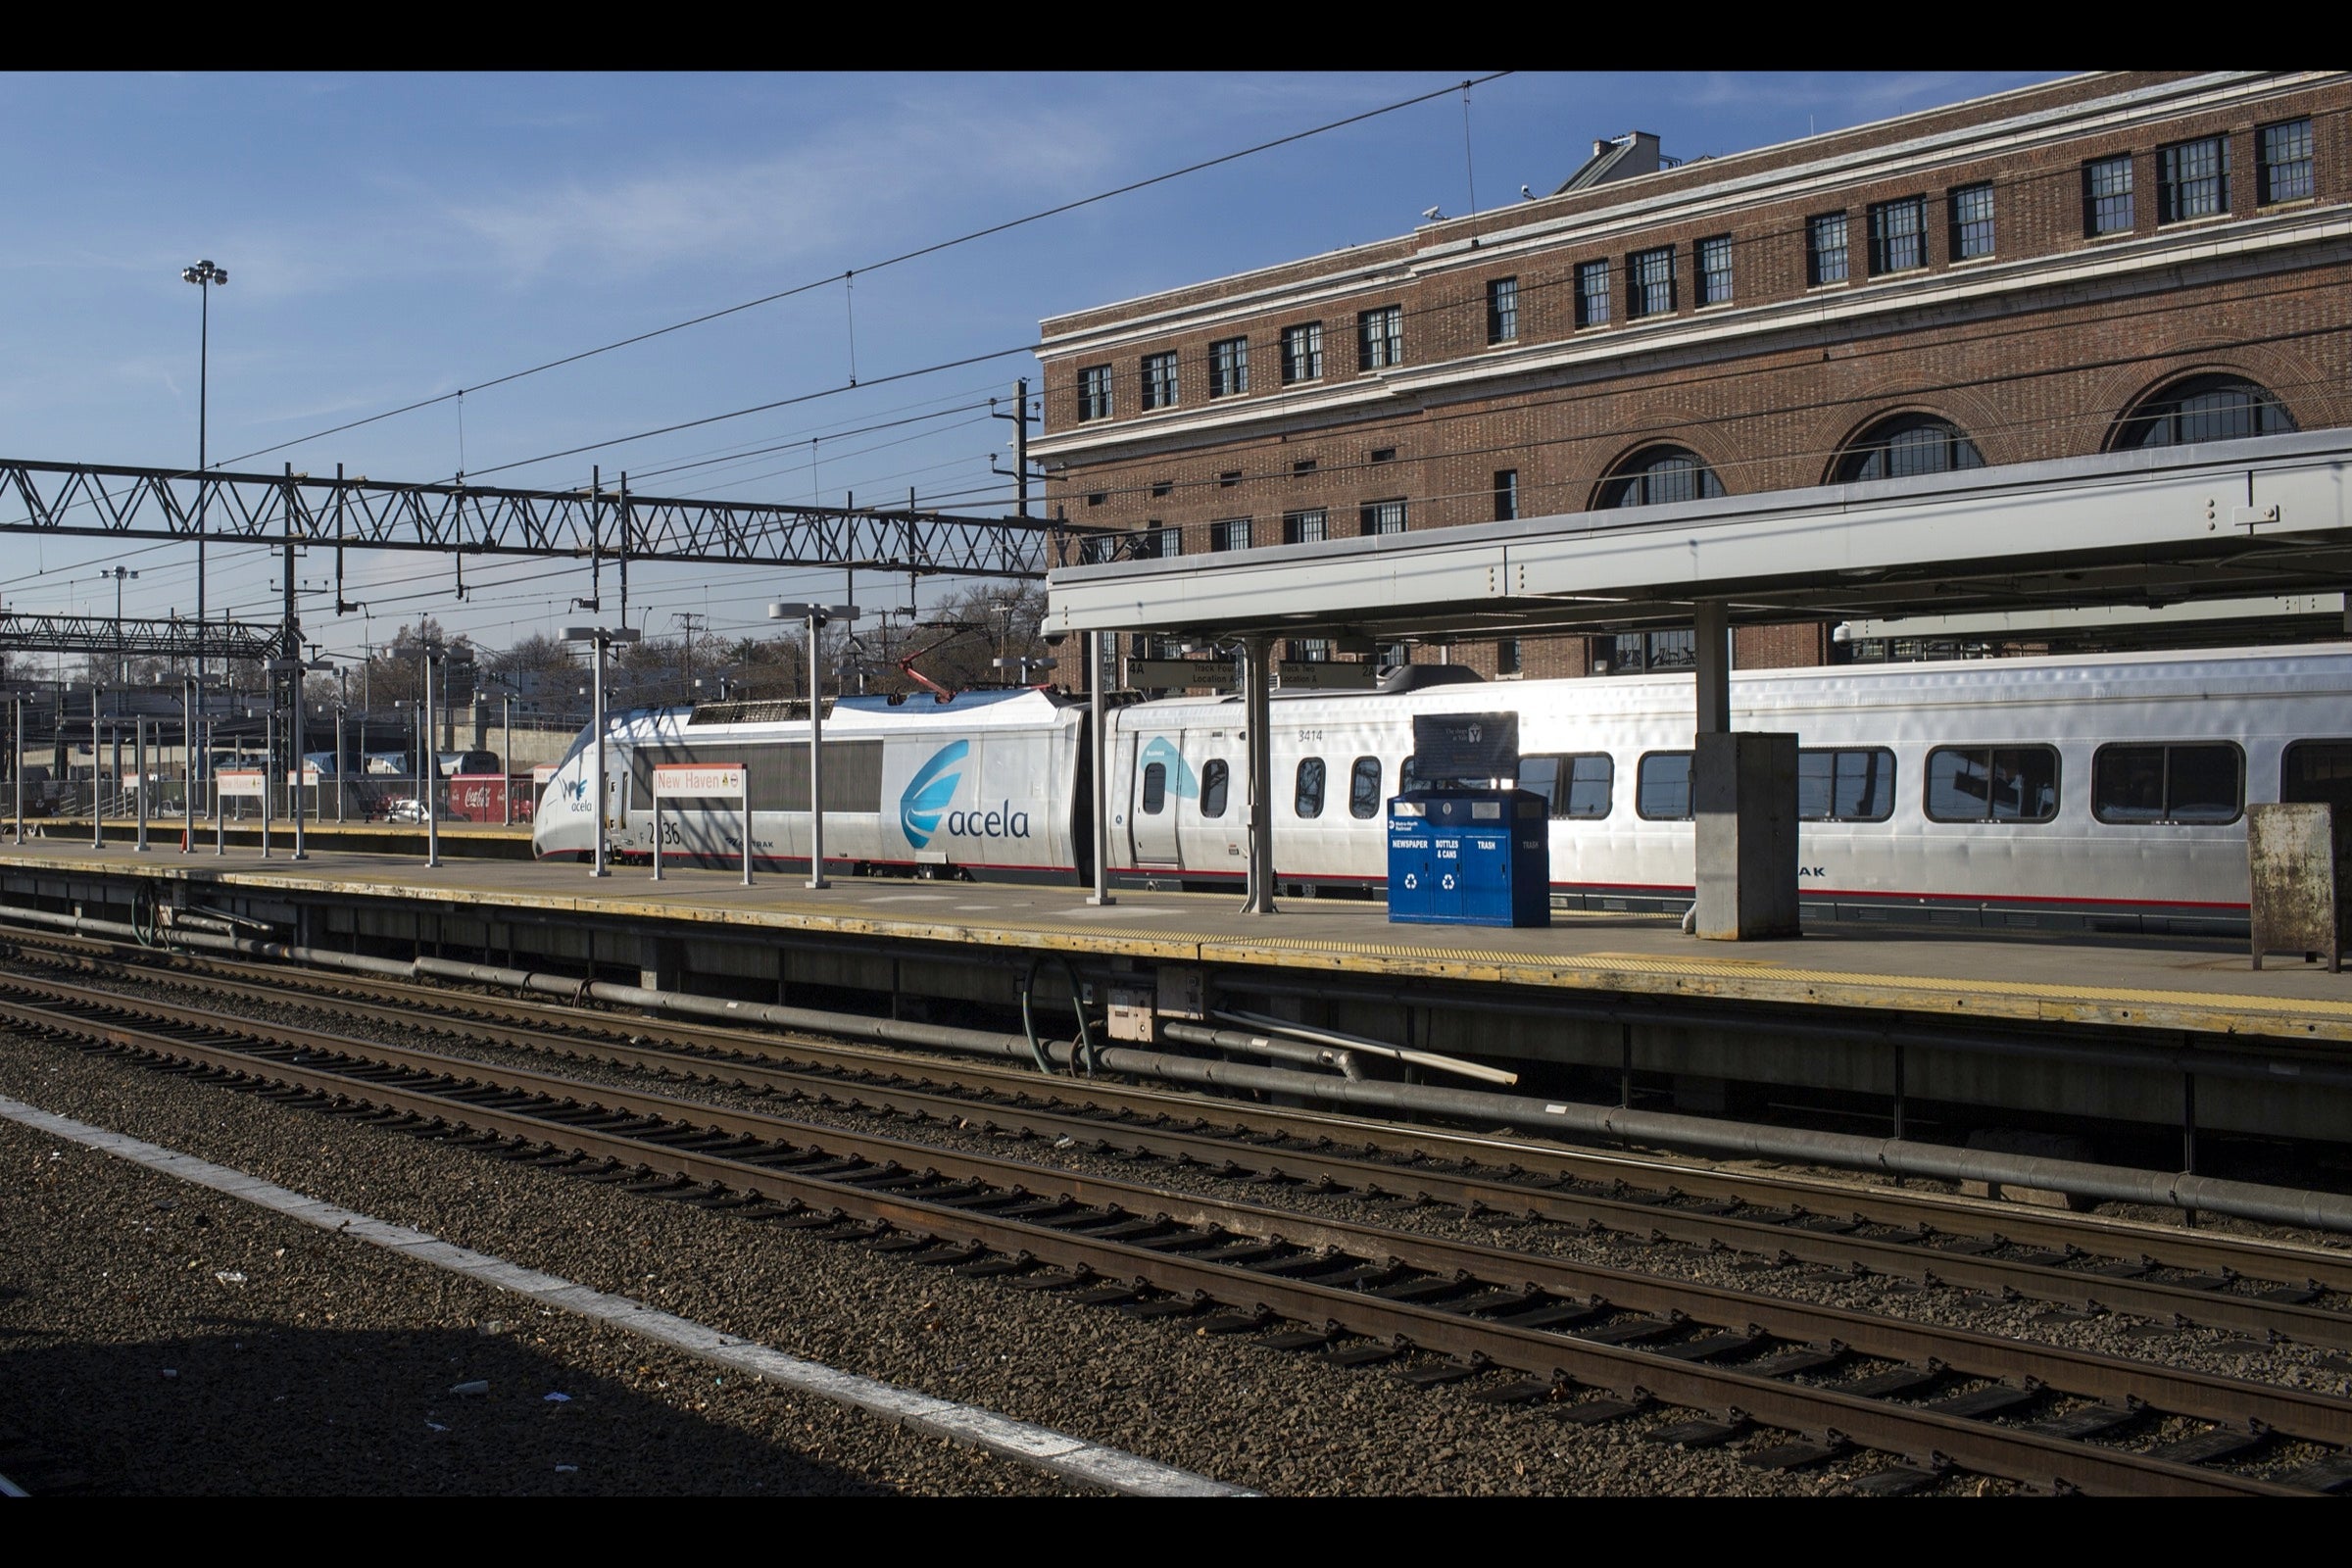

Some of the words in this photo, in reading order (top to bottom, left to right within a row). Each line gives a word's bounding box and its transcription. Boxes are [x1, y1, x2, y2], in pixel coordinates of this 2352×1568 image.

[1129, 663, 1145, 674] 4A
[1195, 663, 1214, 672] Track
[1362, 664, 1375, 677] 2A
[1193, 674, 1227, 683] Location
[1298, 730, 1323, 742] 3414
[658, 772, 680, 789] New
[686, 772, 719, 789] Haven
[571, 801, 592, 812] acela
[948, 799, 1031, 838] acela
[647, 822, 680, 845] 236
[738, 840, 774, 849] ATRAK
[1393, 840, 1428, 849] NEWSPAPER
[1436, 840, 1459, 849] BOTTLES
[1477, 841, 1495, 850] TRASH
[1523, 841, 1540, 850] TRASH
[1437, 850, 1442, 858] &
